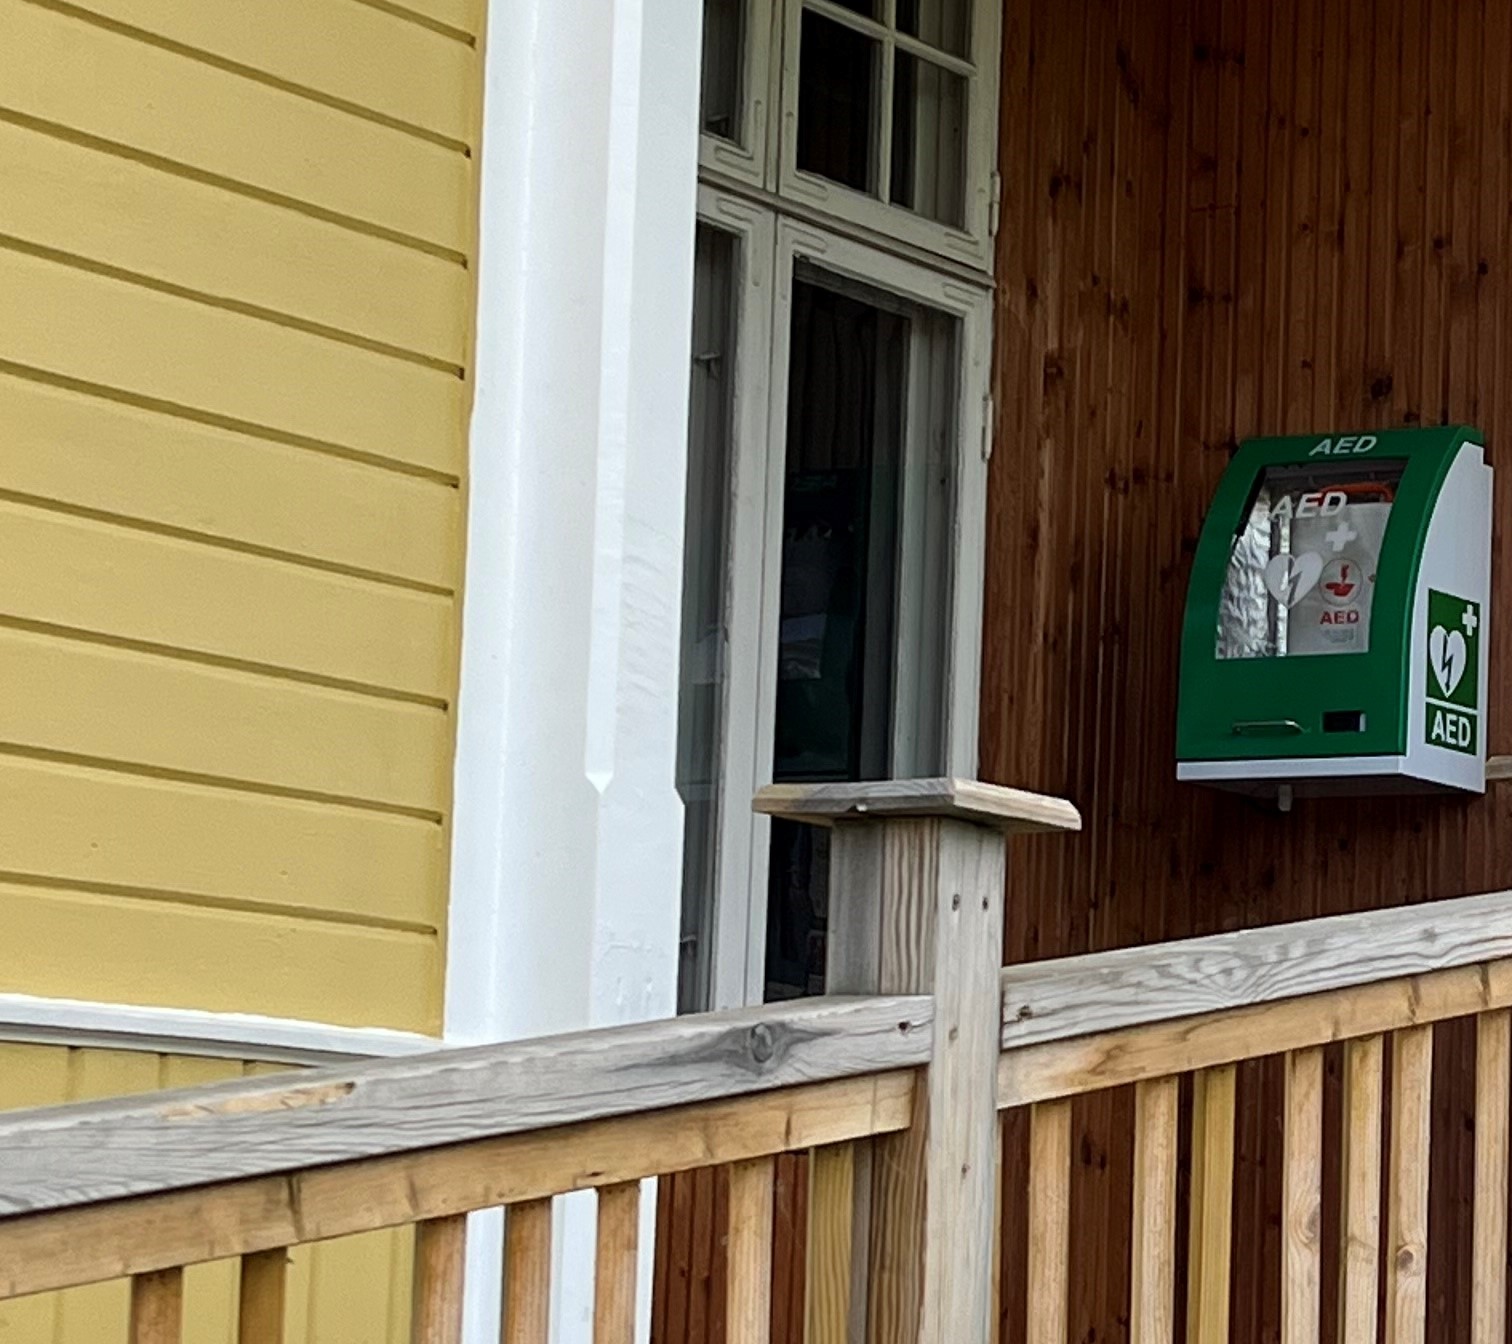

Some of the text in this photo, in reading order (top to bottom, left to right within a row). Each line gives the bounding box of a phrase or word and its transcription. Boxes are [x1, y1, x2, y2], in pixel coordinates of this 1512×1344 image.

[1308, 436, 1377, 457] AED
[1270, 491, 1348, 518] AED
[1320, 610, 1360, 625] AED
[1431, 710, 1472, 748] AED
